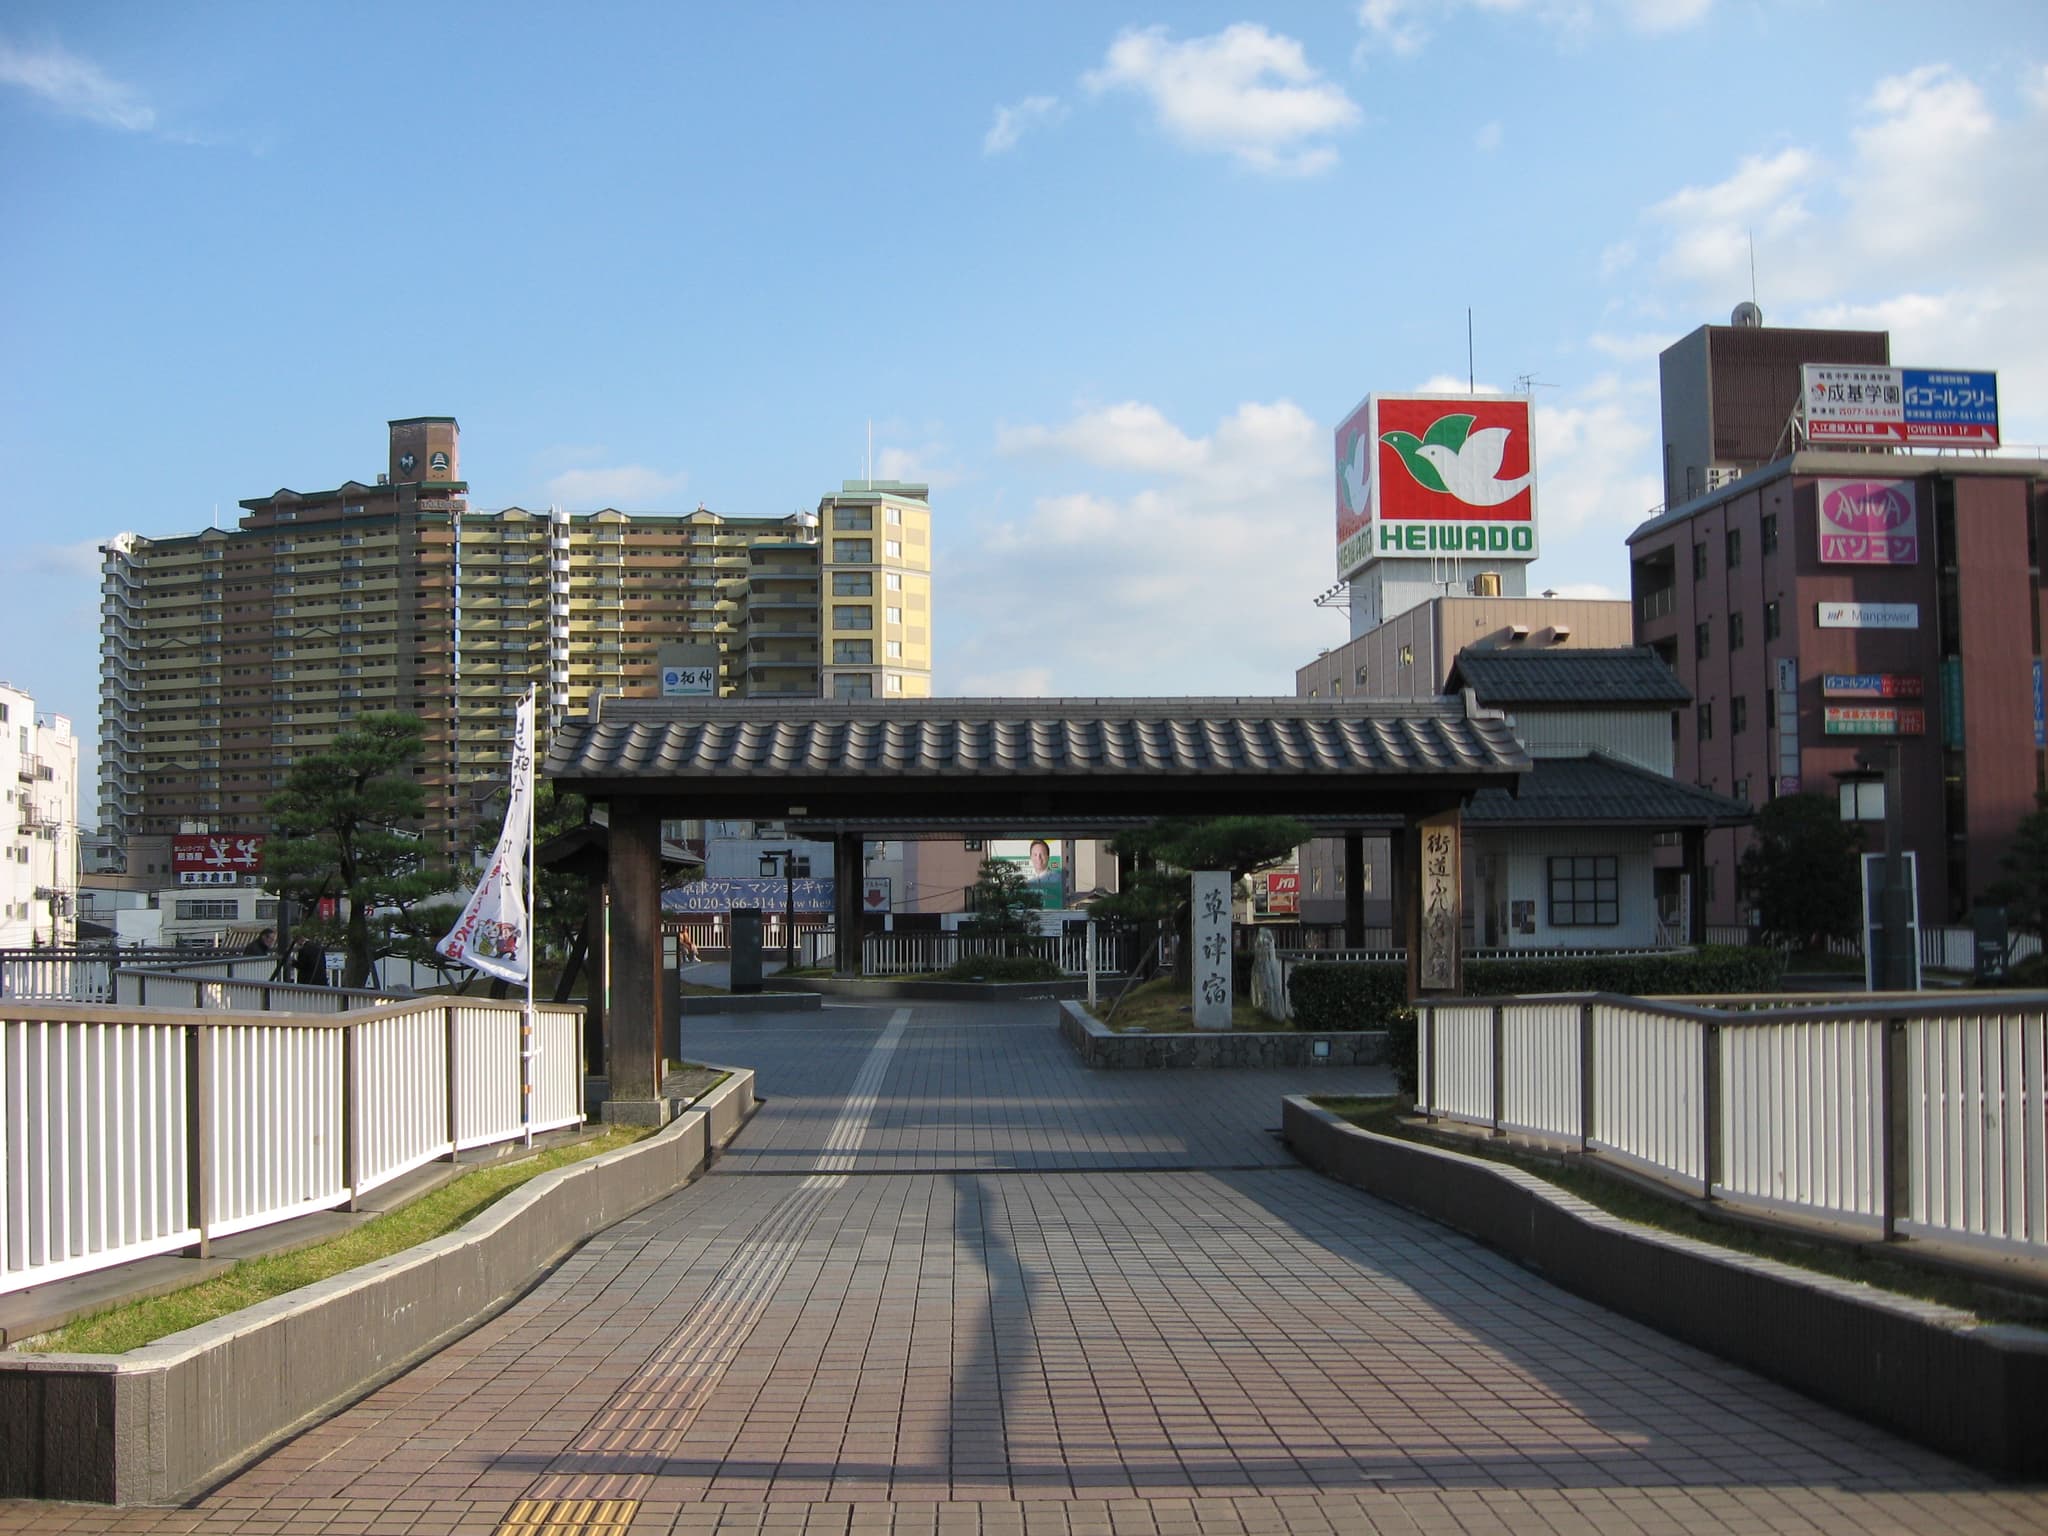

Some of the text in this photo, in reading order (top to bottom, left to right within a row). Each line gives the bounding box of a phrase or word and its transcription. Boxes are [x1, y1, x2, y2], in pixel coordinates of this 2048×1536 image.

[1827, 383, 1899, 404] 成基学園
[1380, 525, 1533, 550] HEIWADO
[1826, 537, 1912, 559] パソコン
[1851, 610, 1910, 624] Manpower
[1275, 877, 1296, 890] JTB
[688, 897, 775, 909] 0120-366-314
[1202, 888, 1227, 1006] 草津宿
